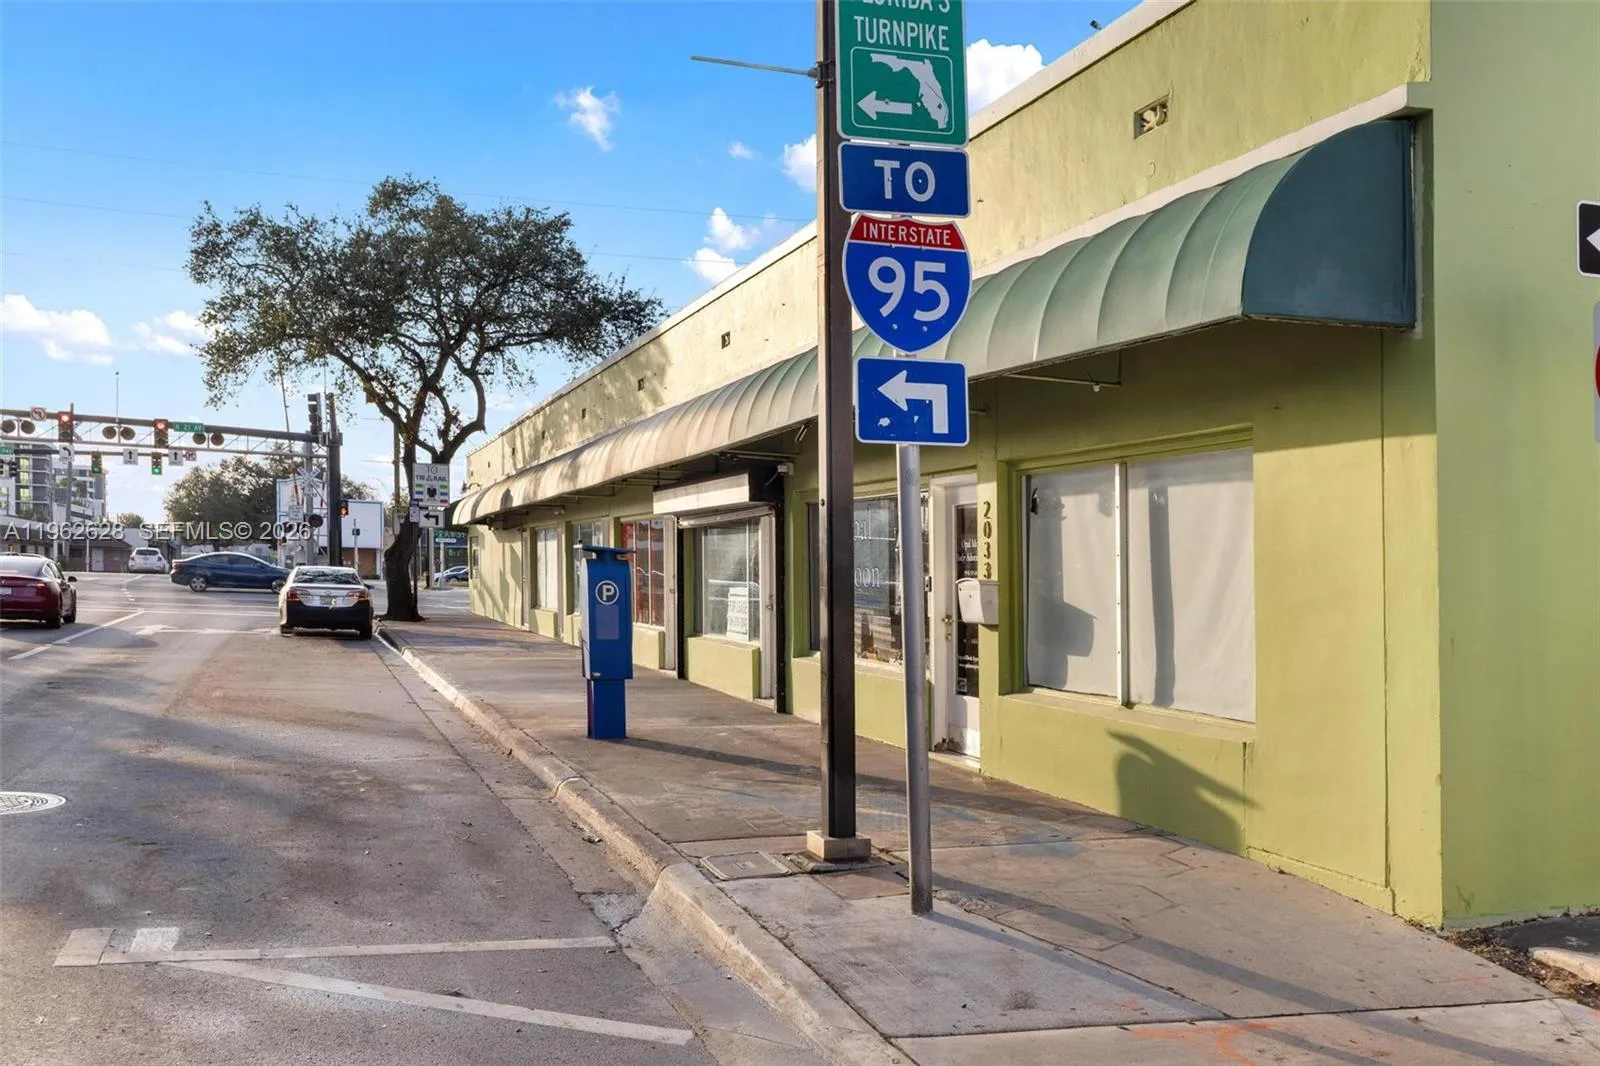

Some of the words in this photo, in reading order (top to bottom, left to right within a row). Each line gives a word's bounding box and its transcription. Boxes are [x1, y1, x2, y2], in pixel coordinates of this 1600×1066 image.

[854, 15, 950, 51] TURNPIKE
[874, 159, 936, 202] TO
[863, 222, 952, 246] INTERSTATE
[868, 256, 950, 322] 95
[983, 500, 992, 579] 2033
[602, 584, 615, 601] P
